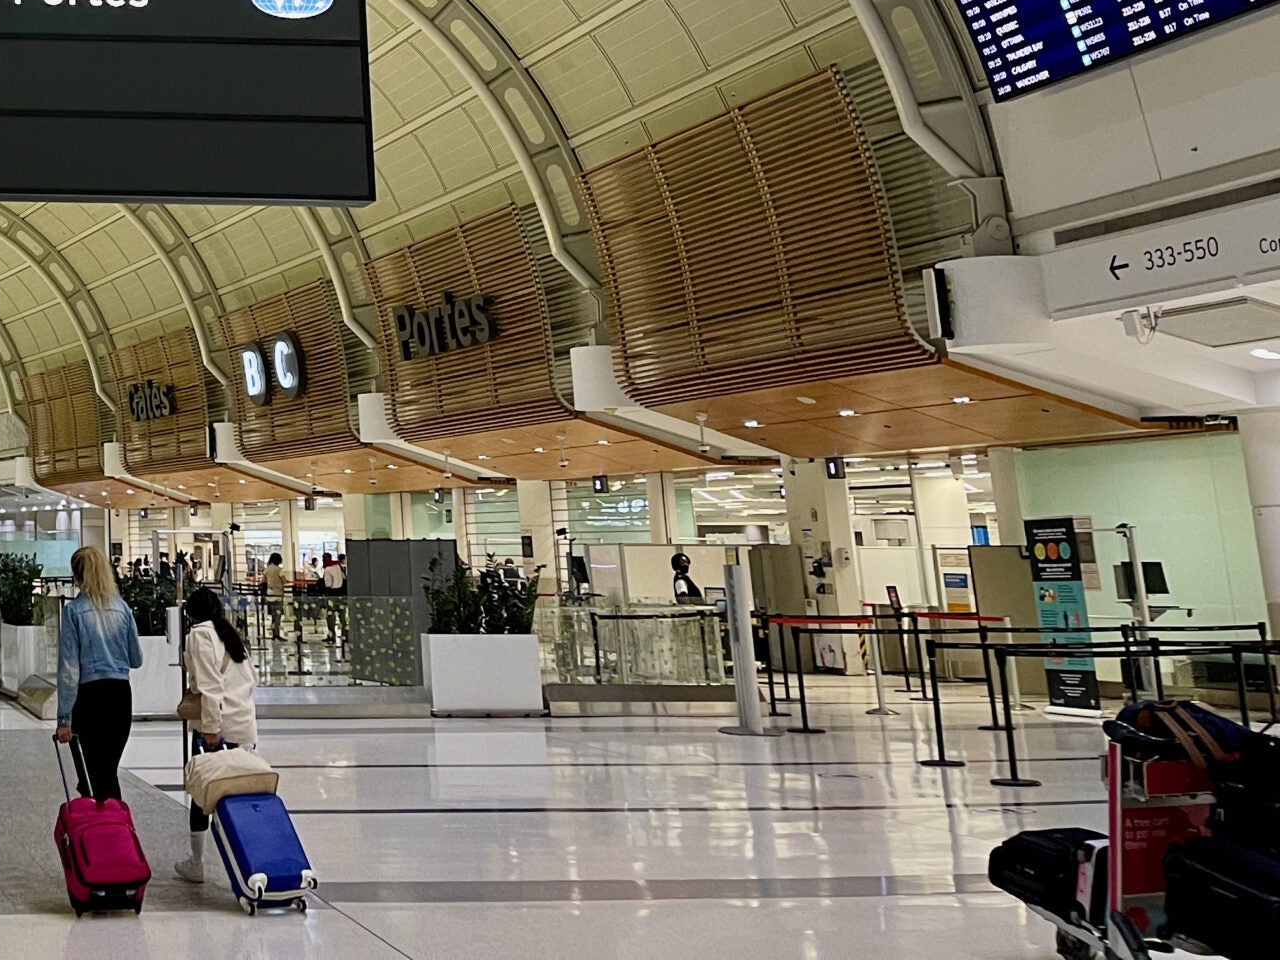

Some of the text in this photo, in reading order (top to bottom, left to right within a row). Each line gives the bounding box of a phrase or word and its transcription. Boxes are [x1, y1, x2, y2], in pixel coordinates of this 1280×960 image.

[1164, 22, 1176, 33] B17
[1183, 16, 1194, 26] On
[1195, 12, 1210, 22] Time
[1178, 0, 1188, 10] On
[1144, 236, 1219, 270] 333-550
[392, 291, 492, 360] Portes
[241, 341, 295, 396] B C
[127, 379, 171, 421] Gates
